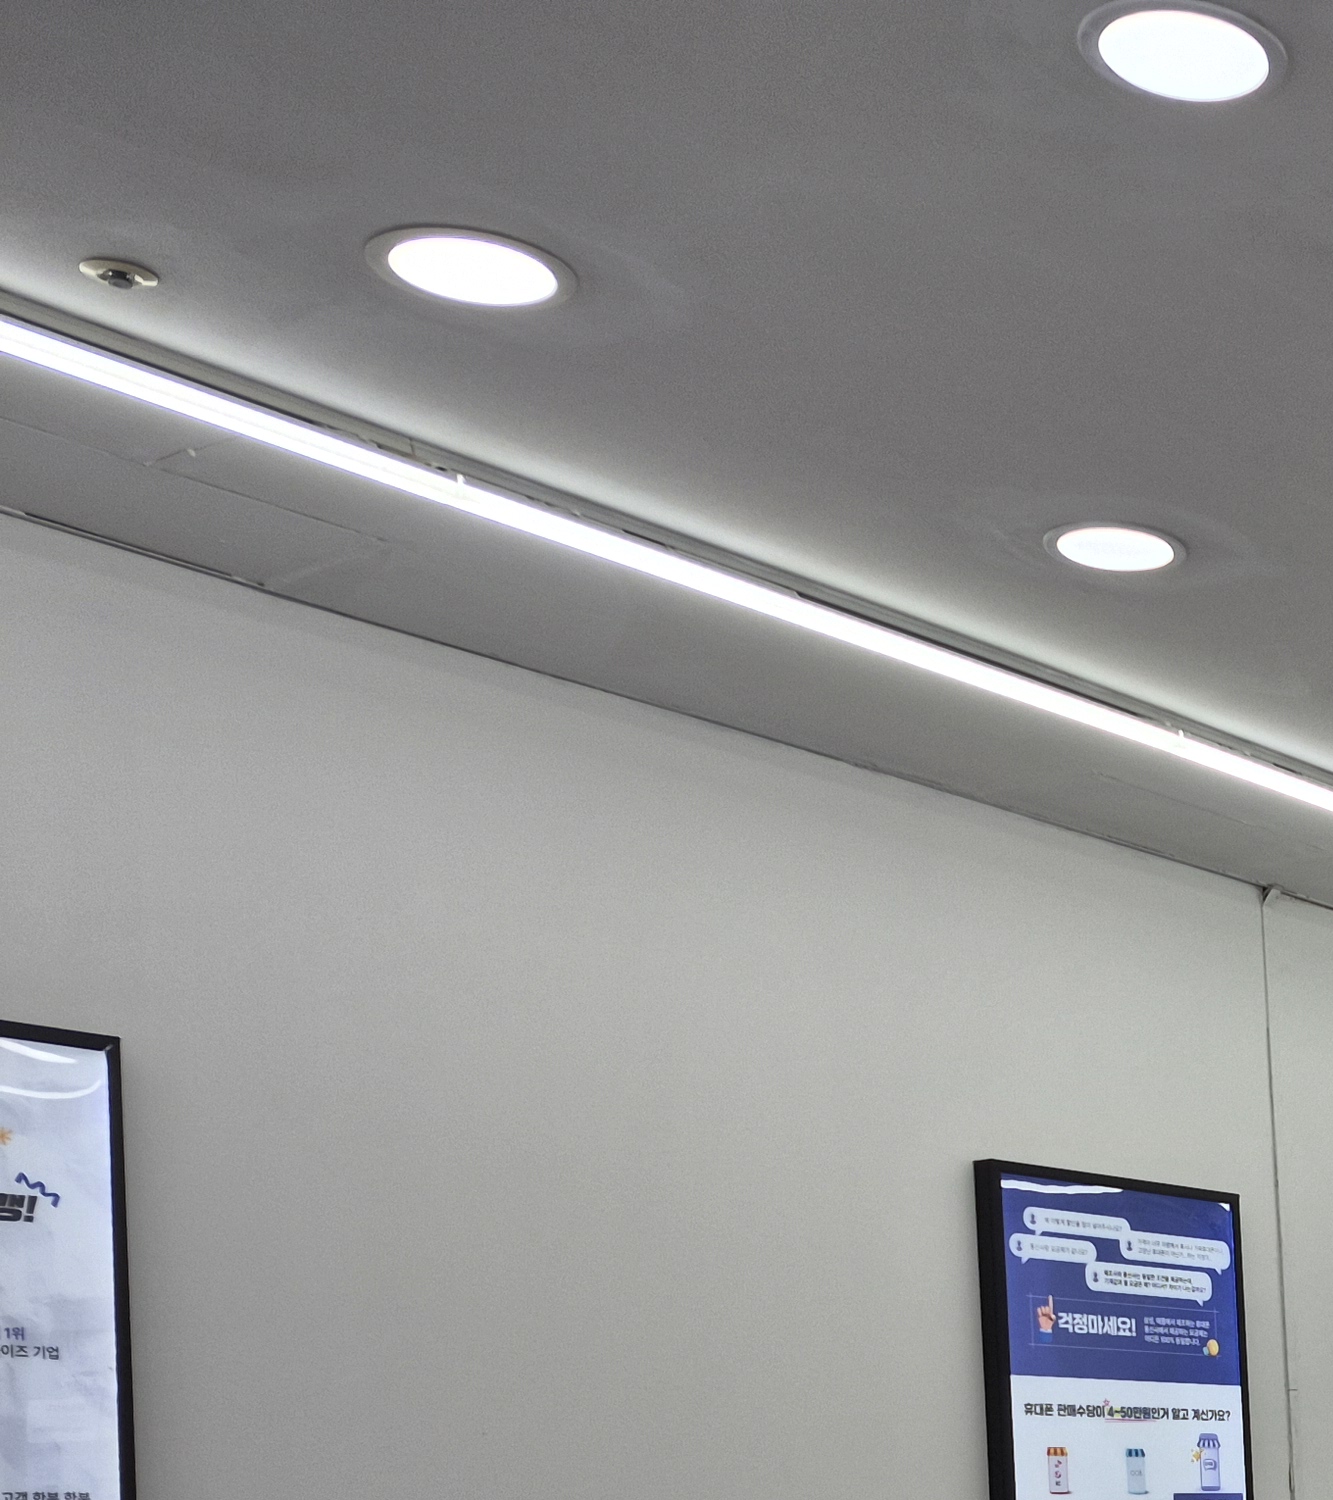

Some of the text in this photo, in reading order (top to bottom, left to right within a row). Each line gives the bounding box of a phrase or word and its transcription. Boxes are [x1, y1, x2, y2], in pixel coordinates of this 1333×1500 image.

[1058, 1312, 1136, 1338] 걱정마세요!
[33, 1346, 59, 1360] 기업
[1024, 1403, 1054, 1416] 휴대폰
[1057, 1404, 1104, 1419] 판매수당이
[1172, 1407, 1189, 1421] 알고
[1192, 1408, 1231, 1422] 계신가요?
